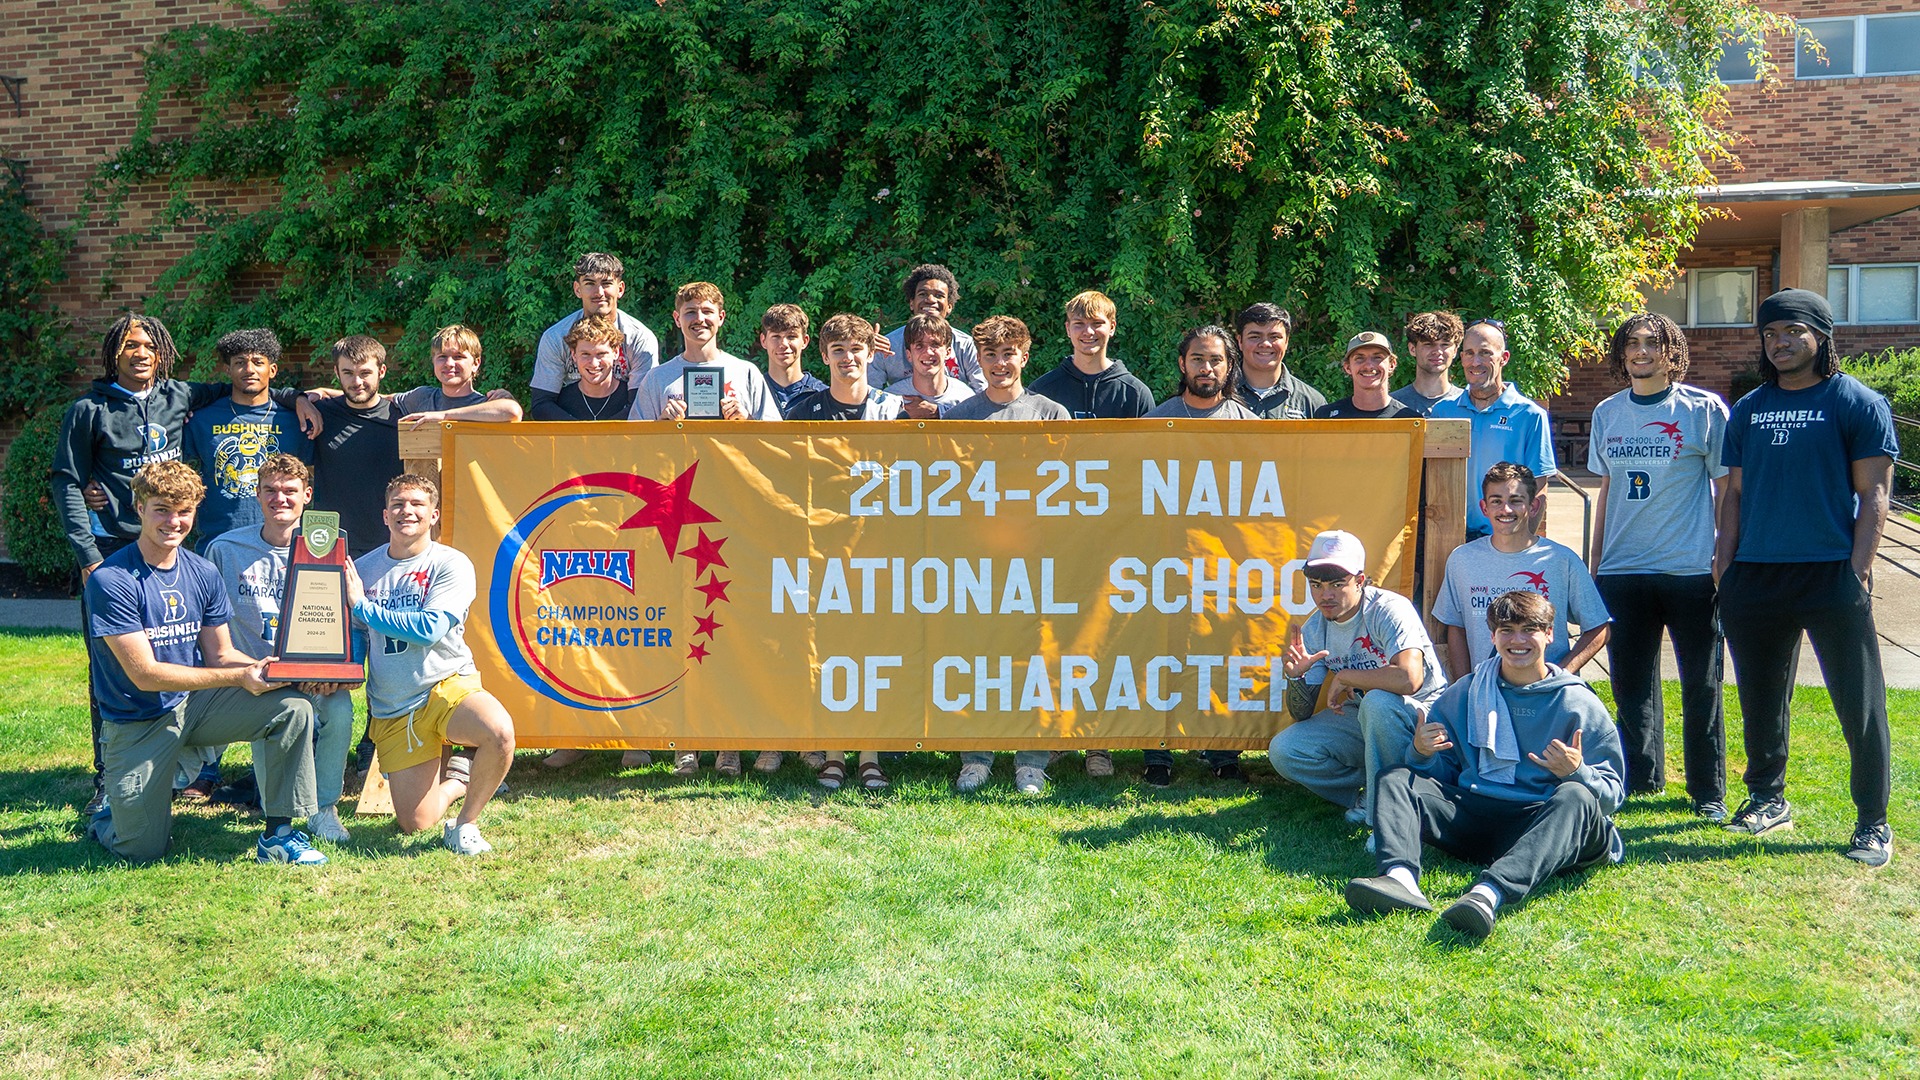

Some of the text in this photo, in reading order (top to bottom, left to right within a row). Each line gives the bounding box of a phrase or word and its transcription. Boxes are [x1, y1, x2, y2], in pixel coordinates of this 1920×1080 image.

[1751, 410, 1825, 424] BUSHNELL
[213, 424, 282, 435] BUSHNELL
[1607, 446, 1671, 458] CHARACTER
[850, 459, 1286, 517] 2024-25 NAIA
[540, 550, 634, 590] NAIA
[260, 577, 285, 586] SCHOO
[771, 557, 1317, 615] NATIONAL SCHOO
[238, 584, 283, 600] CHARAC
[537, 605, 666, 621] CHAMPIONS OF
[145, 621, 201, 639] BUSHNELL
[536, 626, 673, 647] CHARACTER
[820, 656, 903, 712] OF
